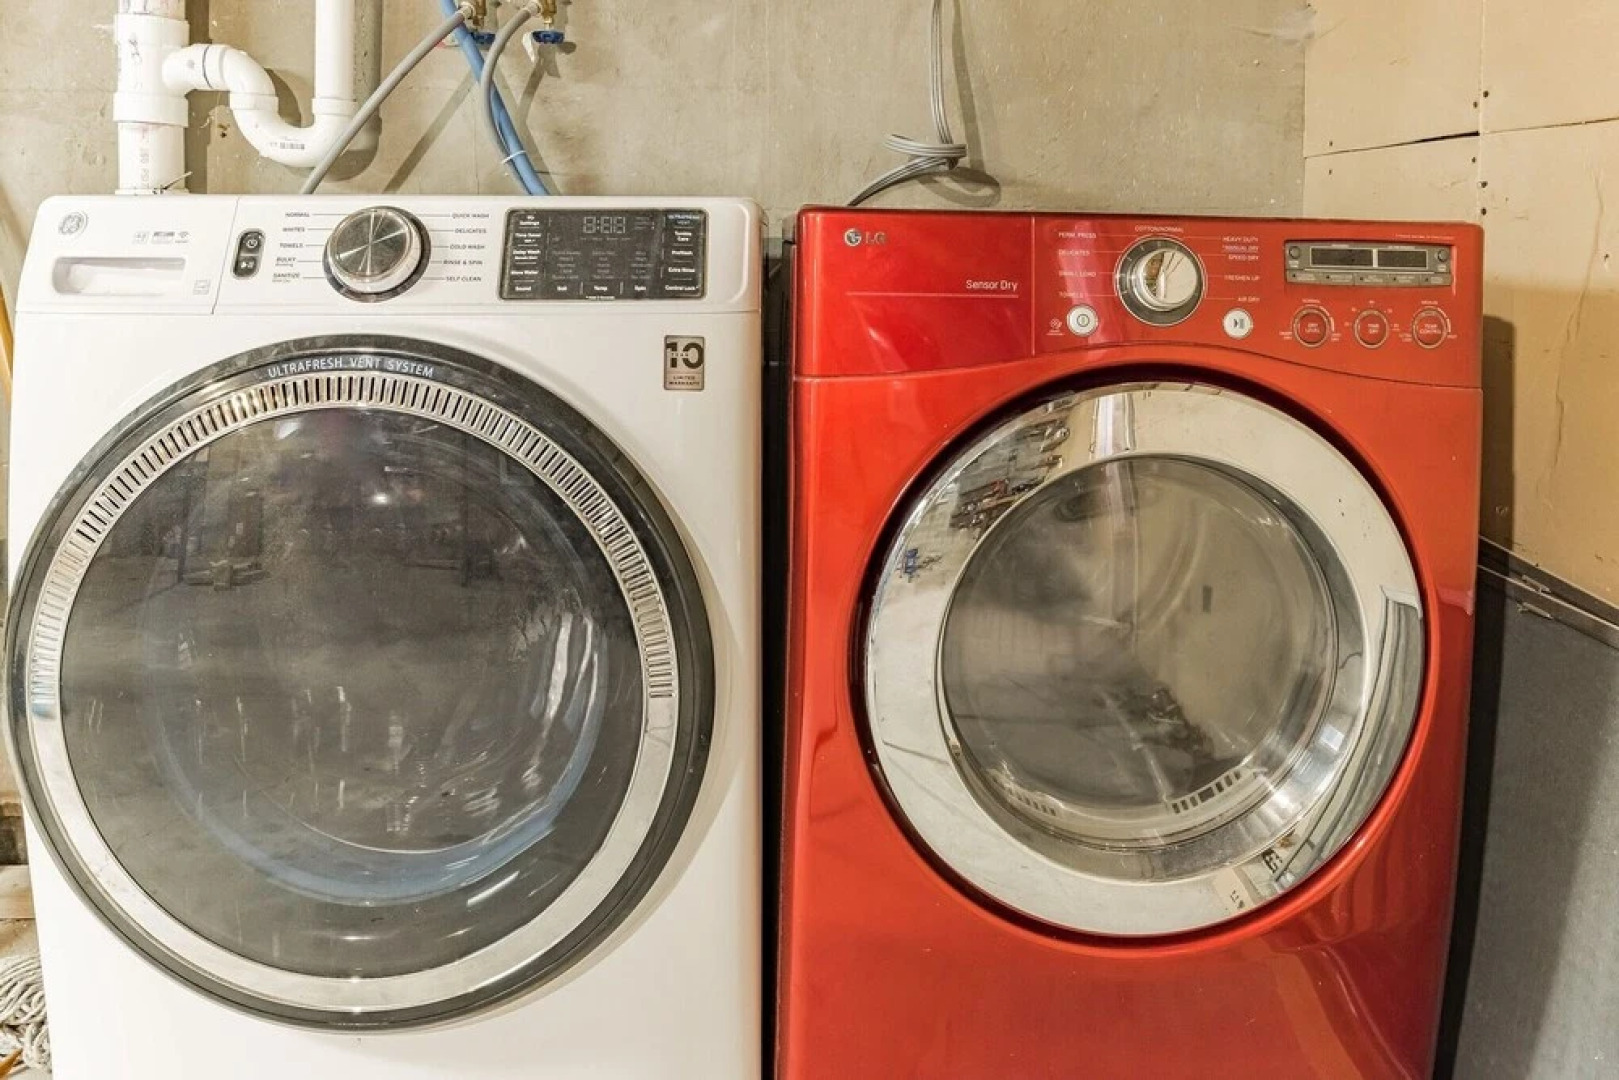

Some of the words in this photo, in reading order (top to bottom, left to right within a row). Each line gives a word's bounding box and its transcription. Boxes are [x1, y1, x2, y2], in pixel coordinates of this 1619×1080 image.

[966, 280, 999, 289] Sensor
[1000, 280, 1018, 292] Dry
[666, 342, 704, 369] 10
[268, 357, 343, 378] ULTRAFRESH
[350, 356, 382, 368] VENT
[386, 359, 434, 378] SYSTEM
